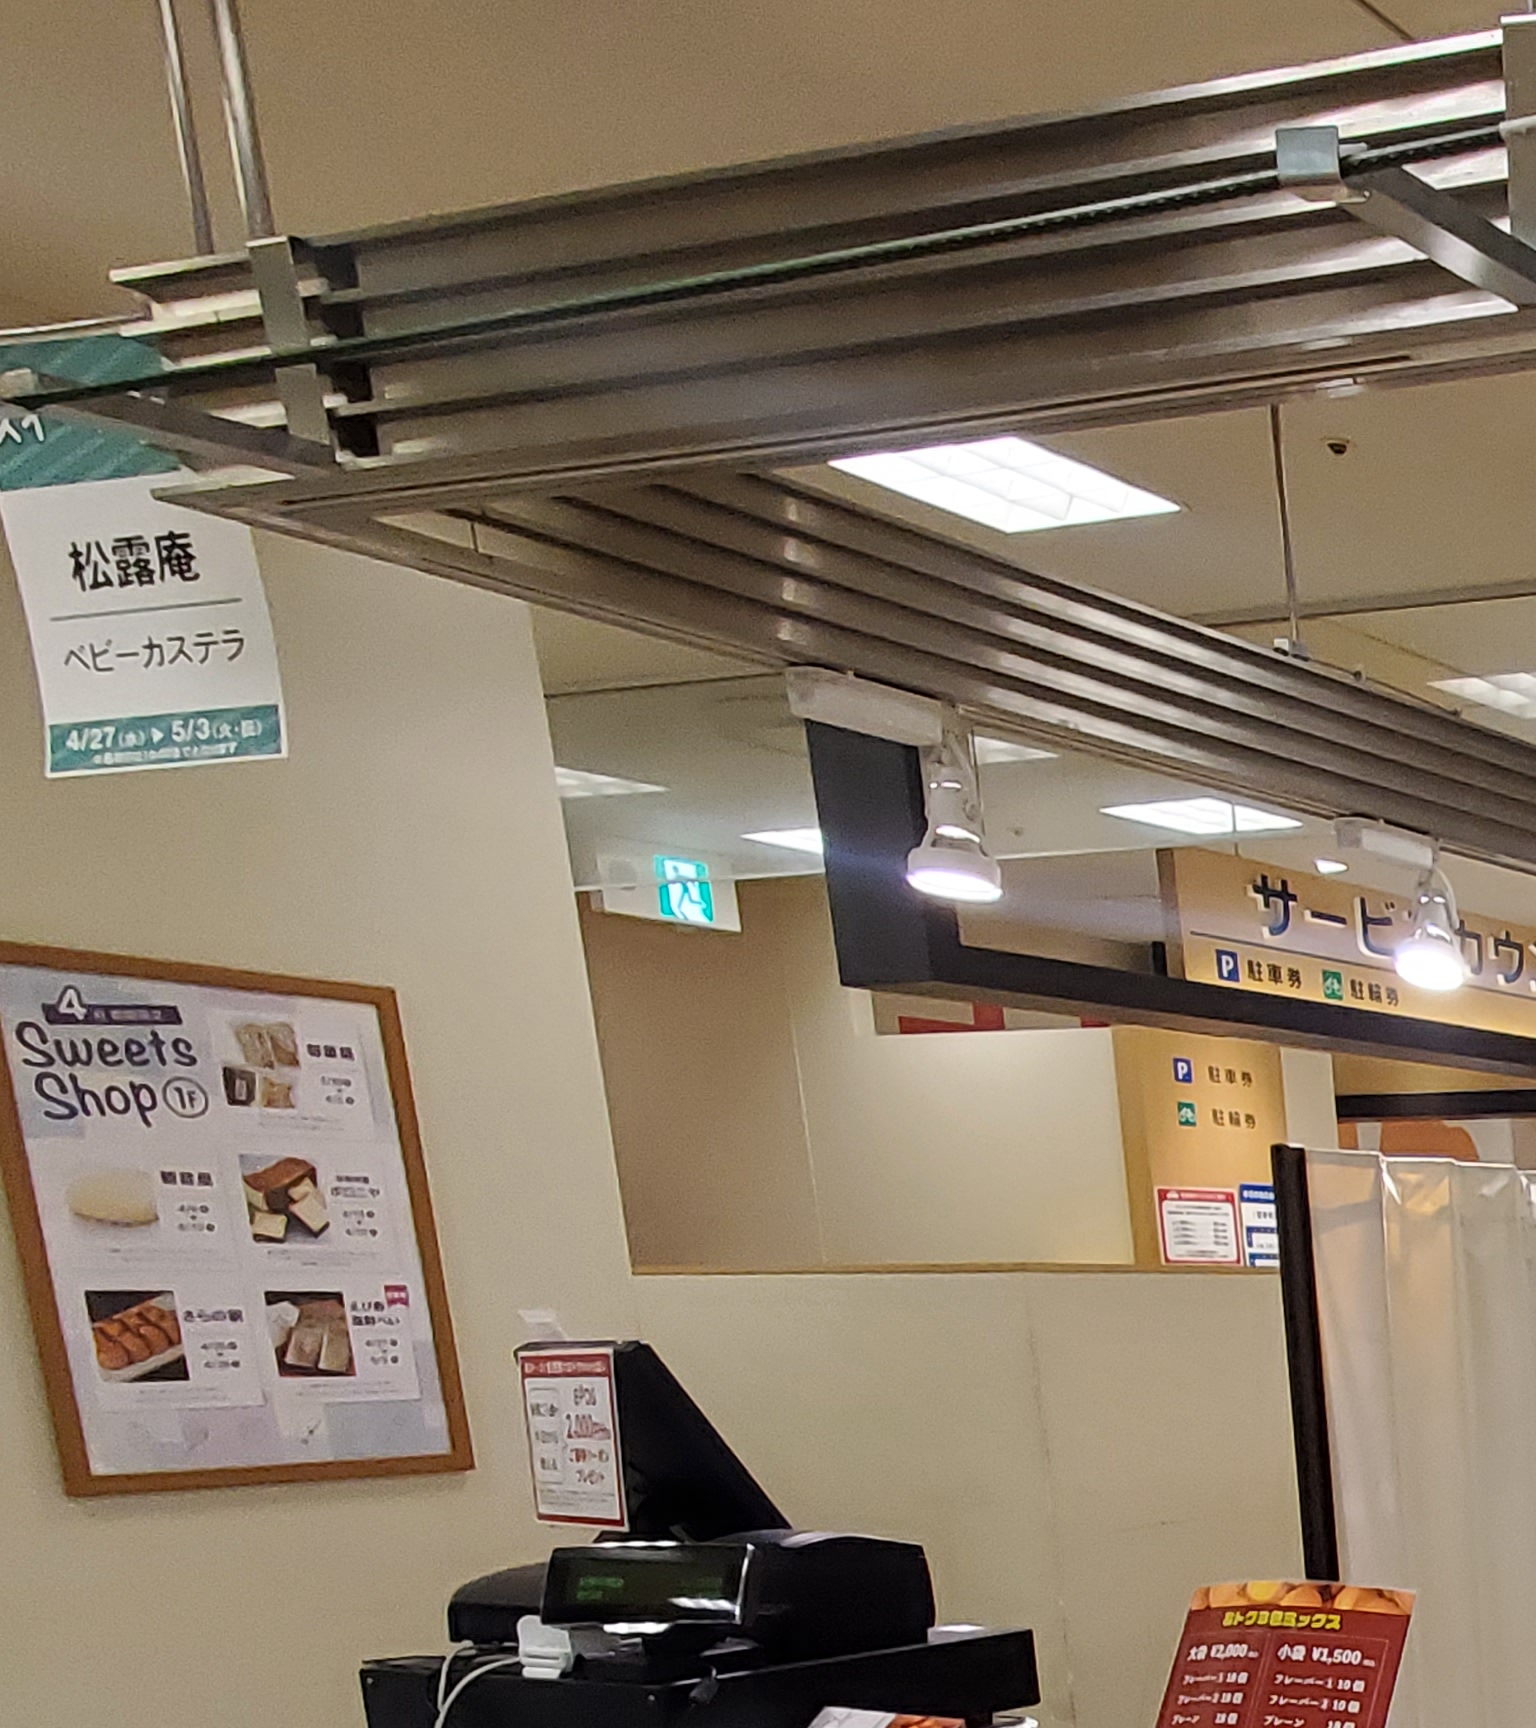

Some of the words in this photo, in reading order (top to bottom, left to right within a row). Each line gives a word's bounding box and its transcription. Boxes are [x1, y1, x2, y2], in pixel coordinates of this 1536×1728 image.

[68, 531, 201, 591] 松露庵
[64, 629, 245, 673] ベビーカステラ
[15, 1020, 198, 1068] Sweets
[35, 1071, 158, 1128] Shop
[173, 1086, 198, 1110] 1F
